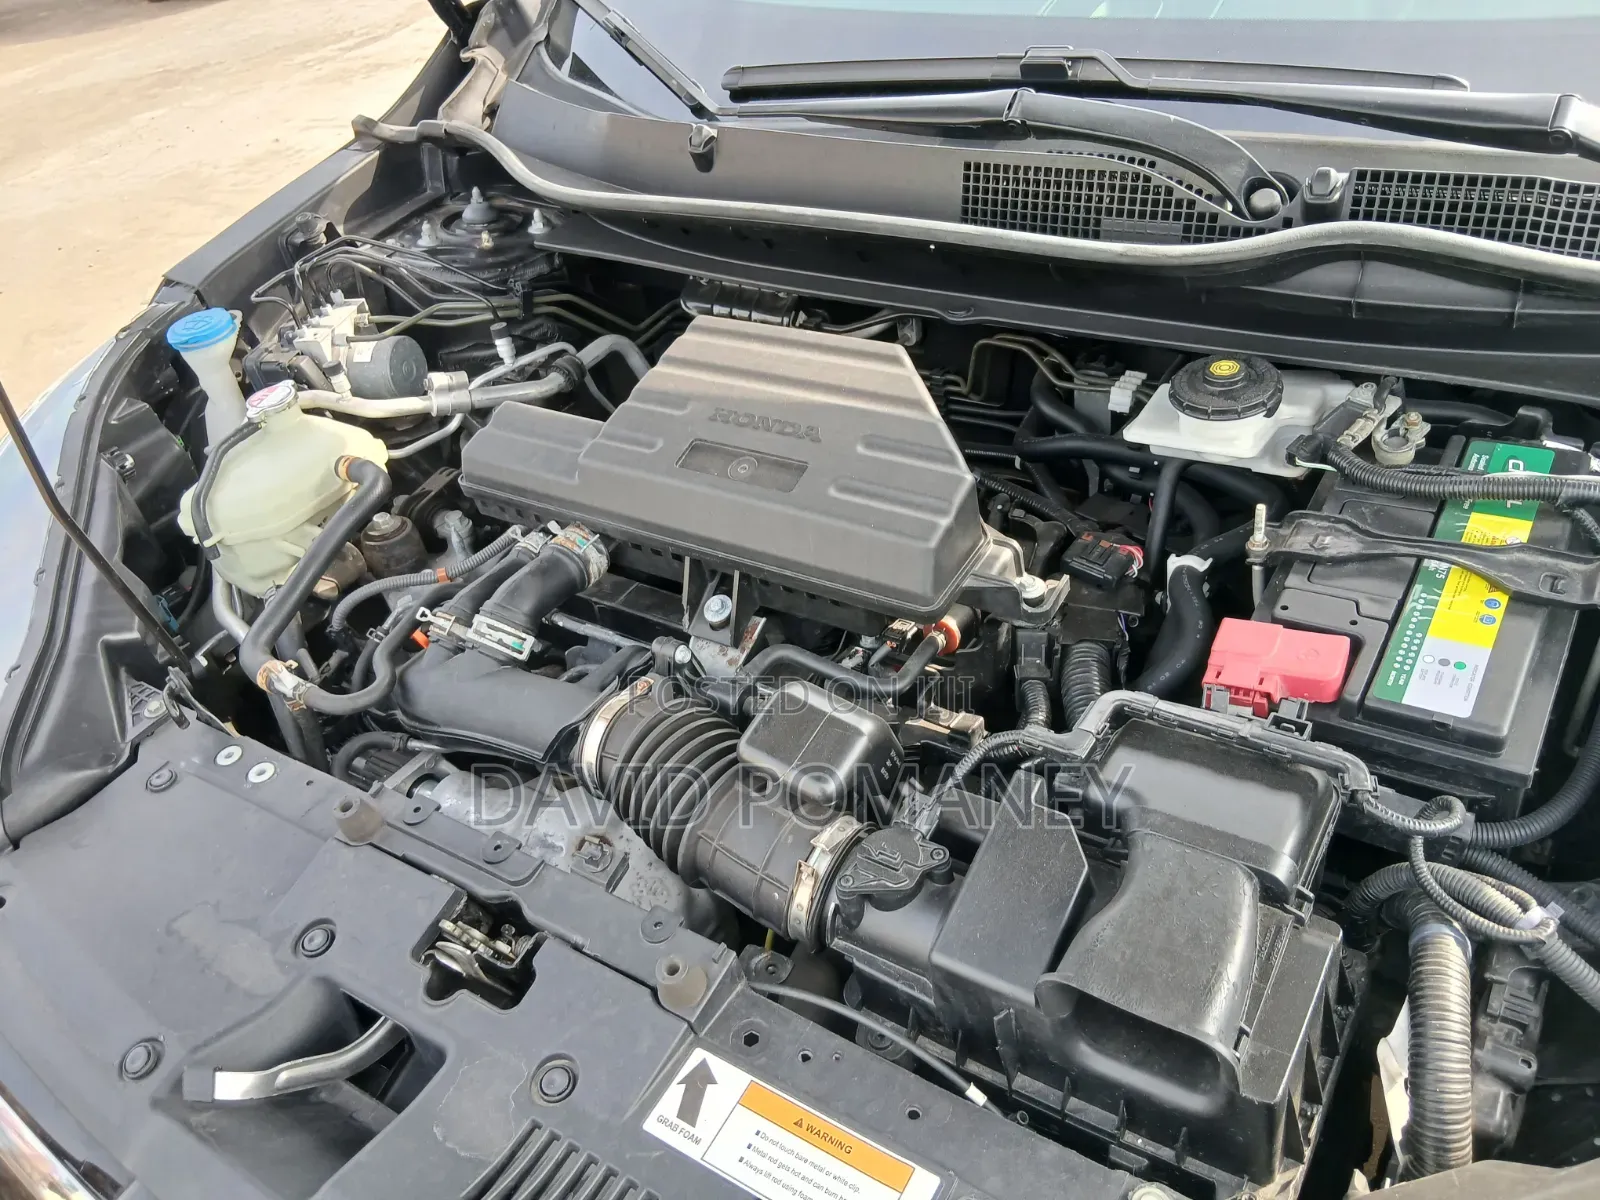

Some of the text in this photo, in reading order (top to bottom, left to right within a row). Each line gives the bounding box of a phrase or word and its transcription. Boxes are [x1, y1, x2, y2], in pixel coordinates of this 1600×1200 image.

[708, 407, 822, 443] HONDA
[656, 1114, 702, 1146] GRAB FOAM
[805, 1123, 853, 1155] WARNING
[751, 1145, 768, 1159] Metal
[767, 1154, 779, 1165] rod
[777, 1160, 791, 1173] gets
[790, 1168, 802, 1178] hot
[800, 1175, 814, 1185] and
[812, 1181, 825, 1191] can
[824, 1187, 839, 1199] burn
[759, 1131, 769, 1141] Do
[768, 1137, 780, 1148] not
[779, 1142, 795, 1157] touch
[794, 1152, 809, 1164] bare
[808, 1160, 826, 1174] metal
[832, 1173, 849, 1187] white
[743, 1159, 763, 1176] Always
[763, 1170, 772, 1180] lift
[771, 1175, 782, 1186] rod
[781, 1181, 798, 1197] using
